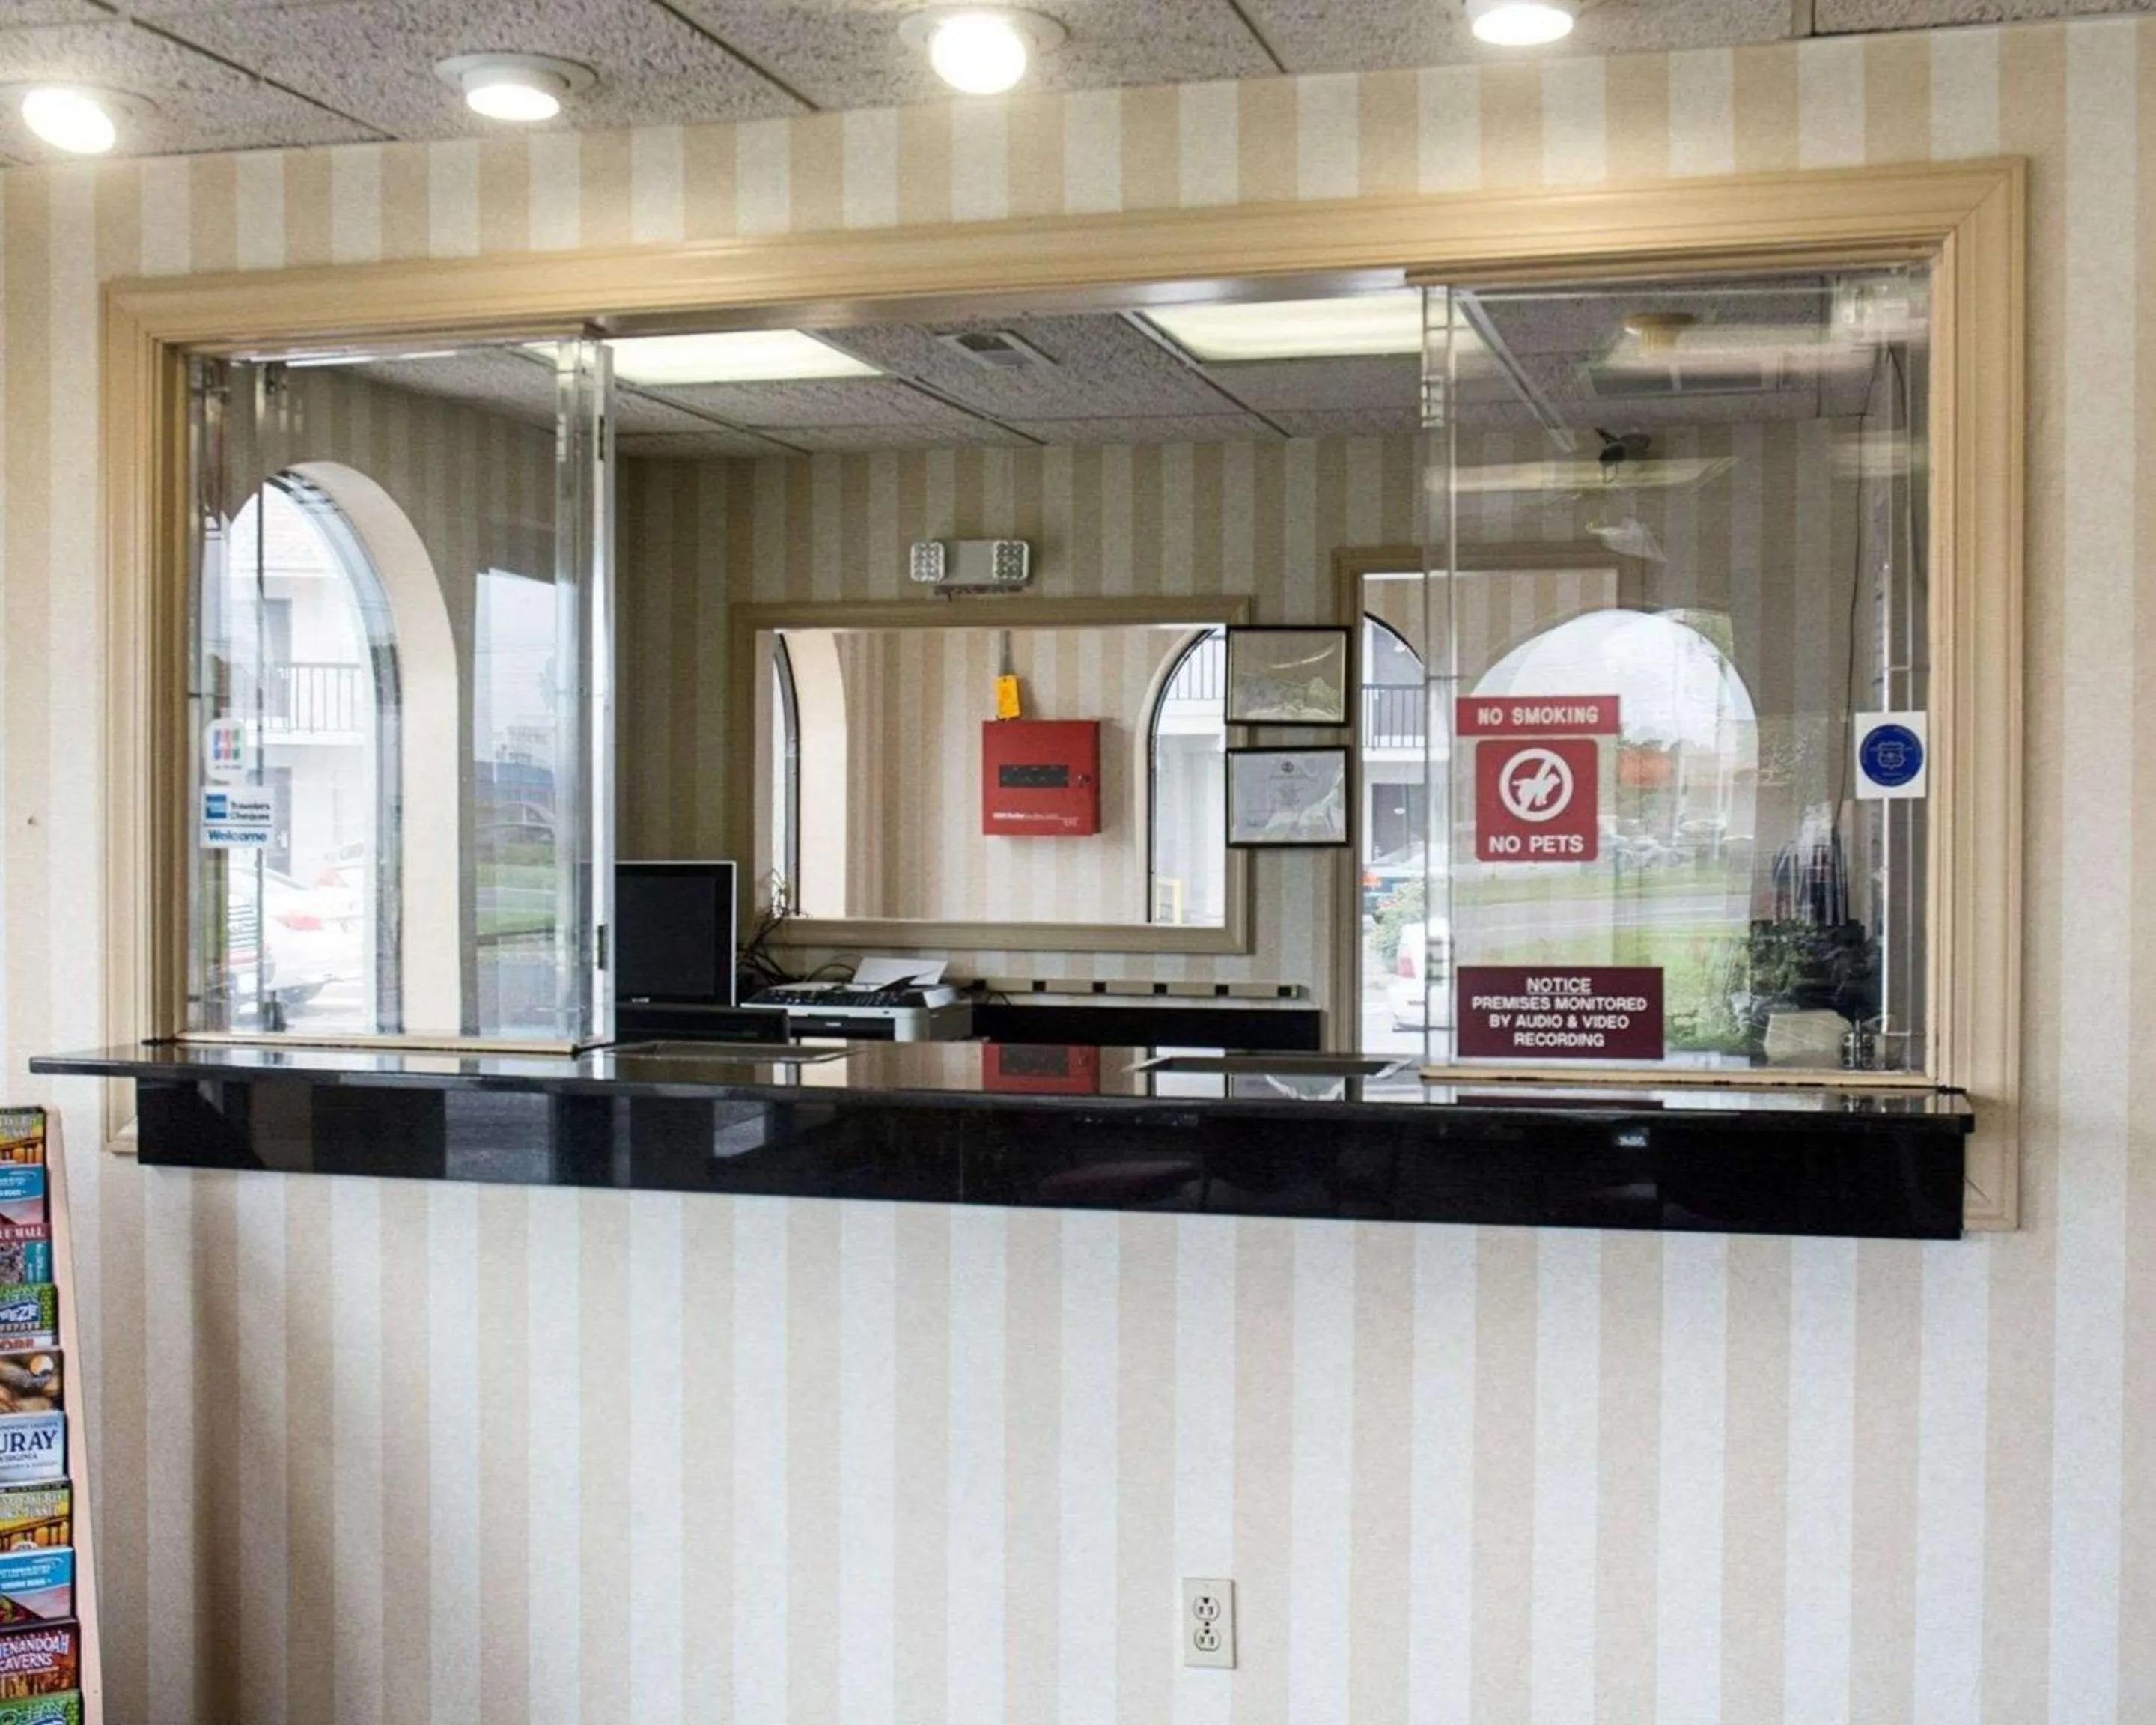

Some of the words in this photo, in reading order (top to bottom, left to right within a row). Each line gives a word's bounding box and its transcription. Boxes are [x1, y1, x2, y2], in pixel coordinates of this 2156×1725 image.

[1477, 708, 1502, 725] NO
[1511, 706, 1599, 725] SMOKING
[208, 830, 267, 842] Welcome
[1489, 836, 1520, 853] NO
[1529, 836, 1583, 853] PETS
[1526, 977, 1591, 993] NOTICE
[1472, 997, 1550, 1010] PREMISES
[1555, 997, 1647, 1011] MONITORED
[1489, 1014, 1511, 1028] BY
[1515, 1014, 1562, 1028] AUDIO
[1567, 1015, 1577, 1028] &
[1583, 1015, 1630, 1029] VIDEO
[1514, 1032, 1604, 1047] RECORDING
